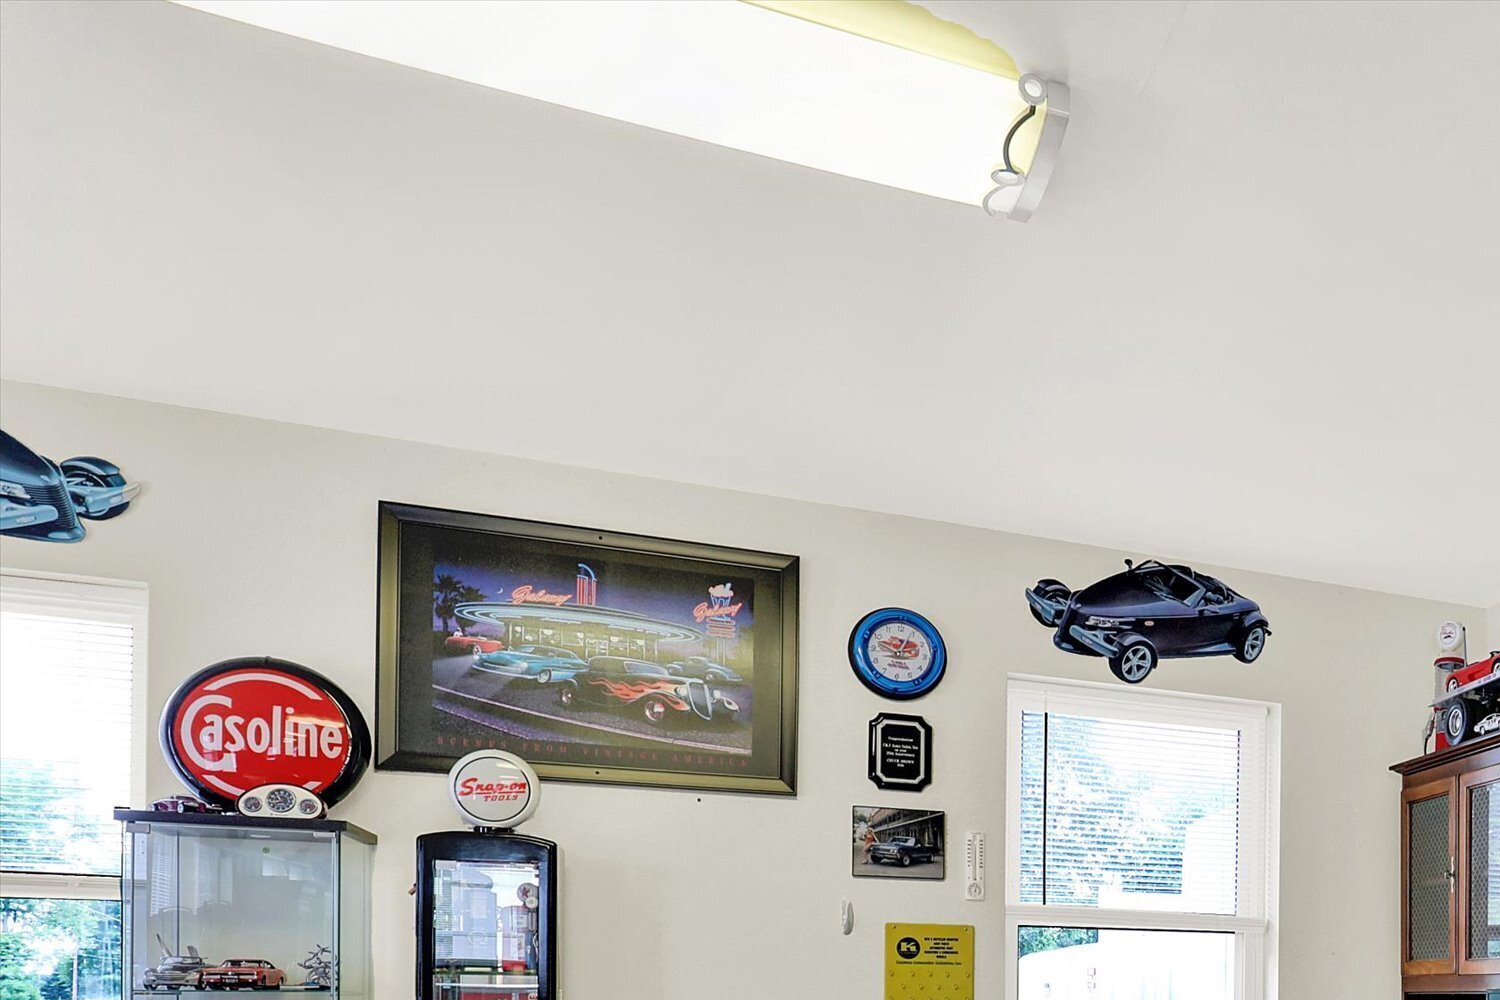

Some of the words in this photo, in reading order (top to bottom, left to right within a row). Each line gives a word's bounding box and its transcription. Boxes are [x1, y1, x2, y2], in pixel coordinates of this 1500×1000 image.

[180, 694, 343, 773] Gasoline
[671, 752, 748, 768] AMERICA
[458, 777, 527, 797] Snap-on
[483, 794, 519, 803] TOOLS
